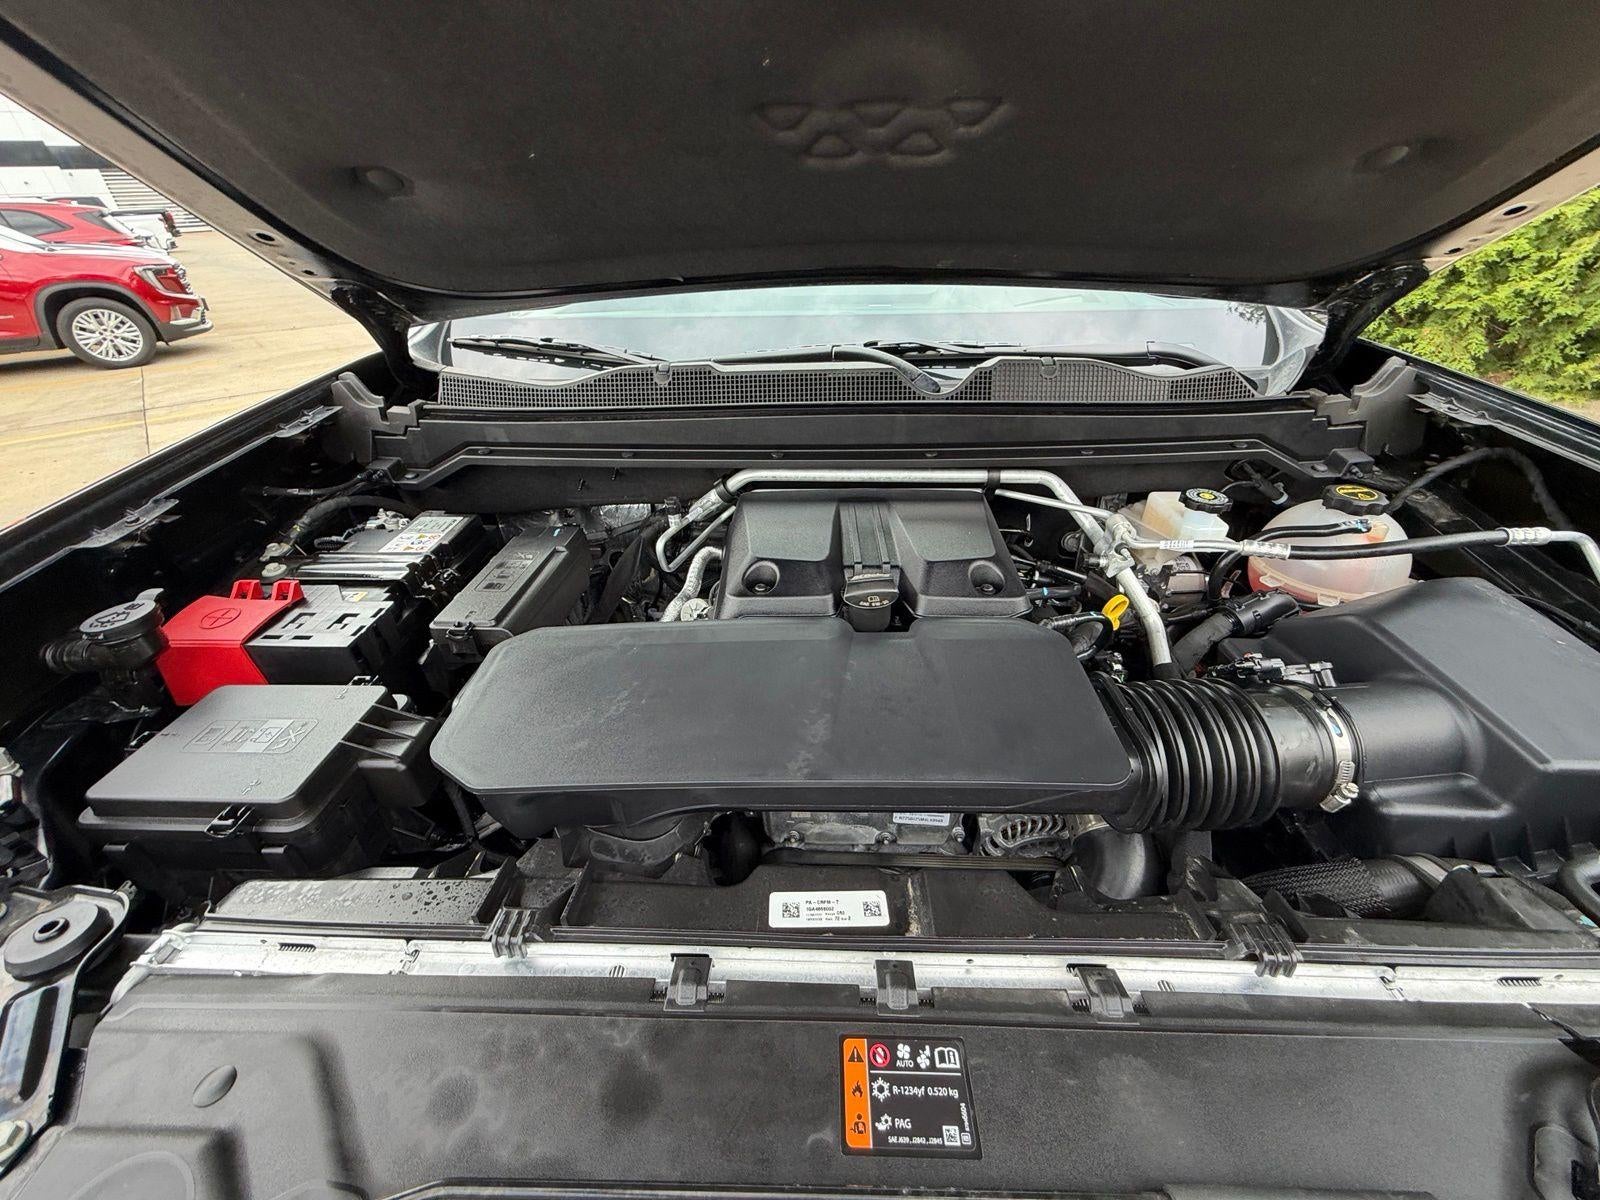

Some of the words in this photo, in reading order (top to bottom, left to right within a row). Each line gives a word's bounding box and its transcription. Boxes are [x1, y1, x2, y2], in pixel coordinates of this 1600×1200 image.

[896, 1059, 914, 1068] AUTO
[892, 1085, 925, 1097] R-1234yf
[927, 1086, 948, 1096] 0.520
[948, 1086, 959, 1099] kg
[894, 1118, 912, 1129] PAG
